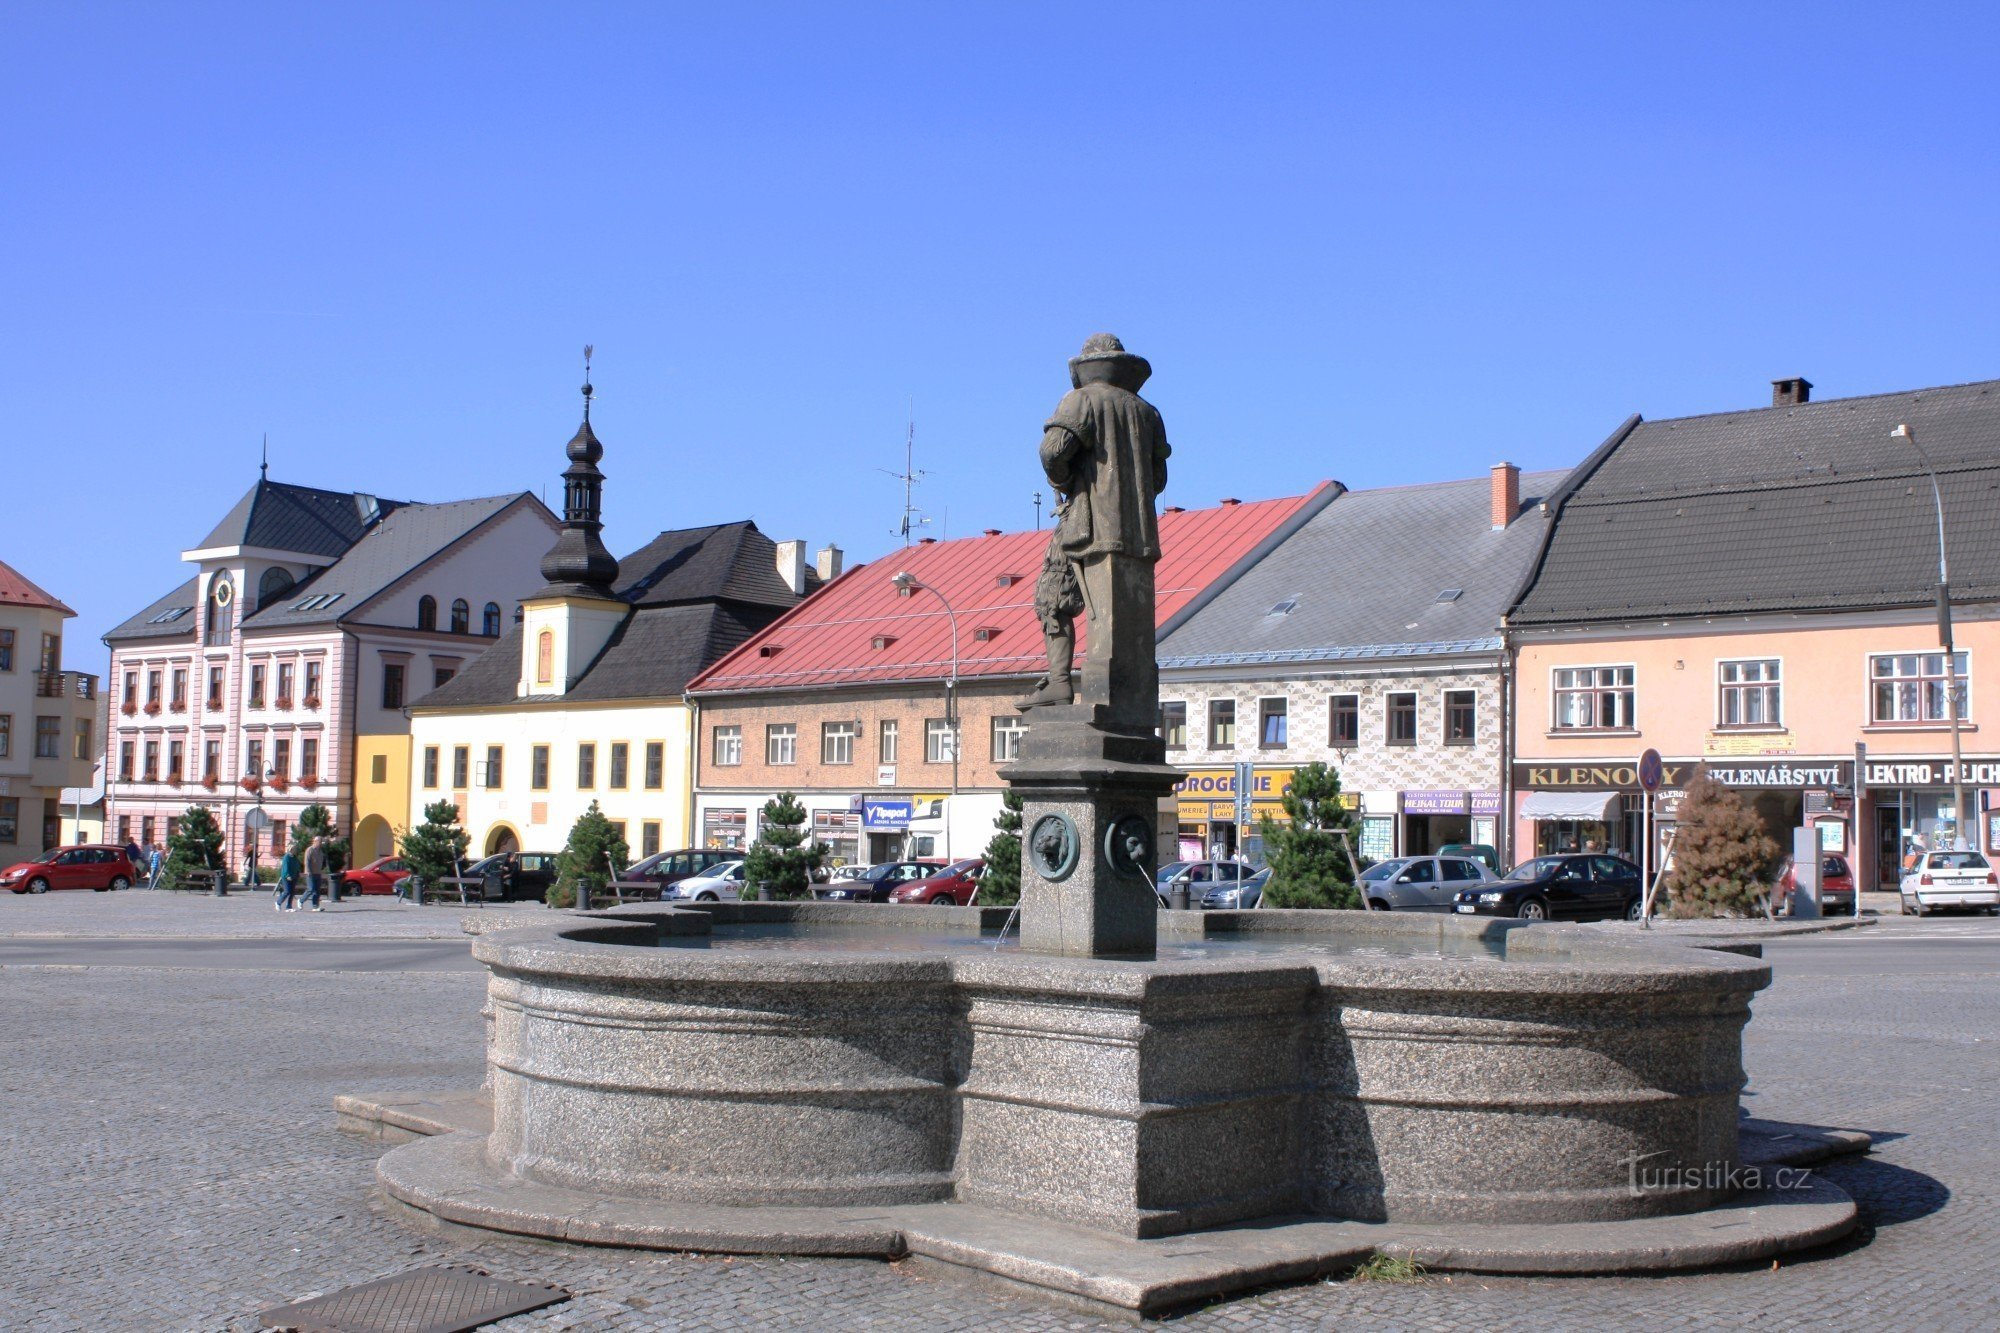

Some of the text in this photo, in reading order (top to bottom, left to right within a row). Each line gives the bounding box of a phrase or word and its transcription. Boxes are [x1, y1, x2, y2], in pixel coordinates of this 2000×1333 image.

[1528, 767, 1681, 786] KLENOY
[1705, 765, 1839, 785] SKLENÁŘSTVÍ
[1865, 765, 1931, 784] LEKTRO
[1175, 776, 1272, 792] DROGEIE
[1440, 799, 1463, 808] TOUR
[1471, 797, 1500, 808] ČERNÝ
[877, 806, 907, 820] Tipsport
[1252, 807, 1286, 815] OSMETIK
